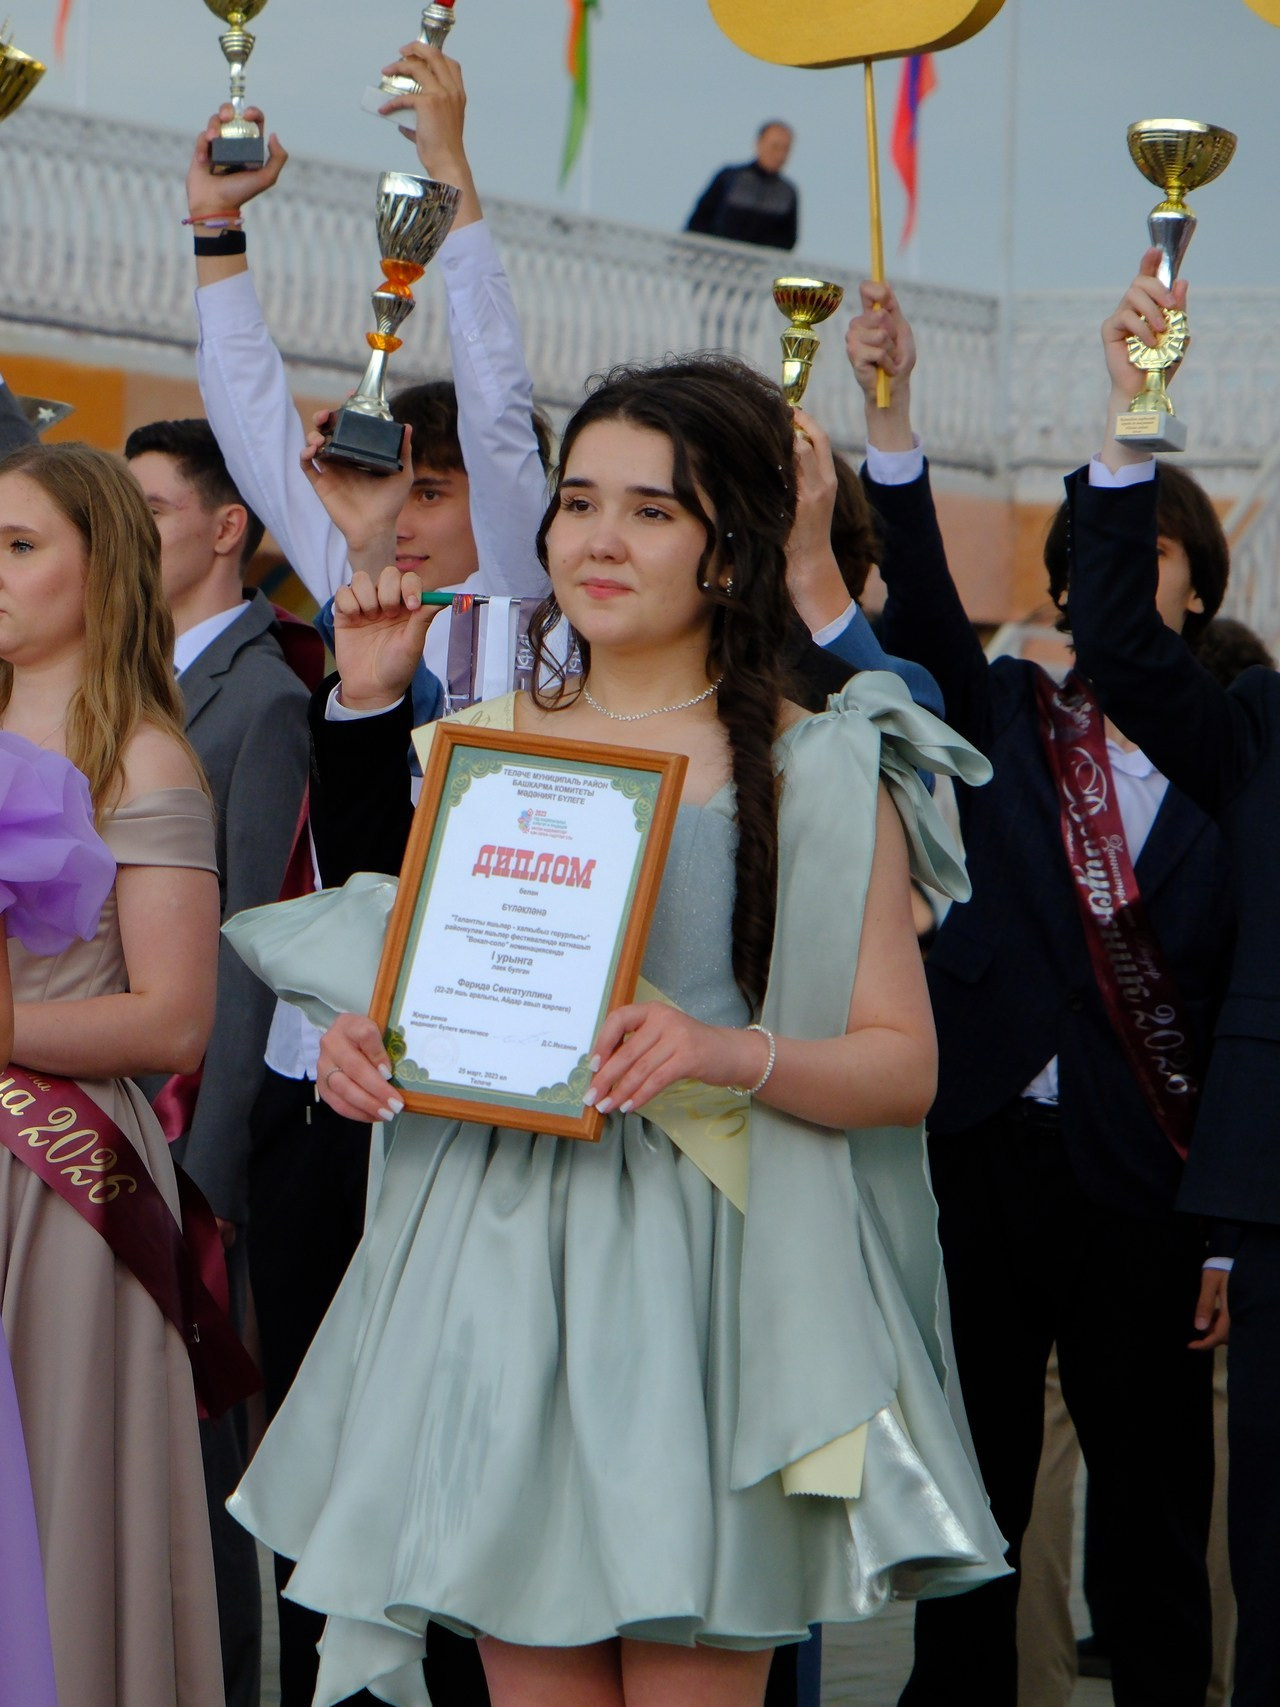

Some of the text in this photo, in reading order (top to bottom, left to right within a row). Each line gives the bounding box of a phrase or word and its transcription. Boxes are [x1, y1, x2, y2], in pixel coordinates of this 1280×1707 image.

[512, 779, 595, 797] БАШКАРМА КОМИТЕТЫ
[532, 772, 581, 786] МУНИЦИПАЛЬ
[583, 779, 608, 789] РАЙОН
[472, 844, 597, 889] ДИПЛОМ
[501, 903, 548, 917] БҮЛӘКЛӘНӘ
[497, 952, 533, 967] урынга
[457, 978, 491, 992] Фәридә
[18, 1106, 138, 1204] 2026
